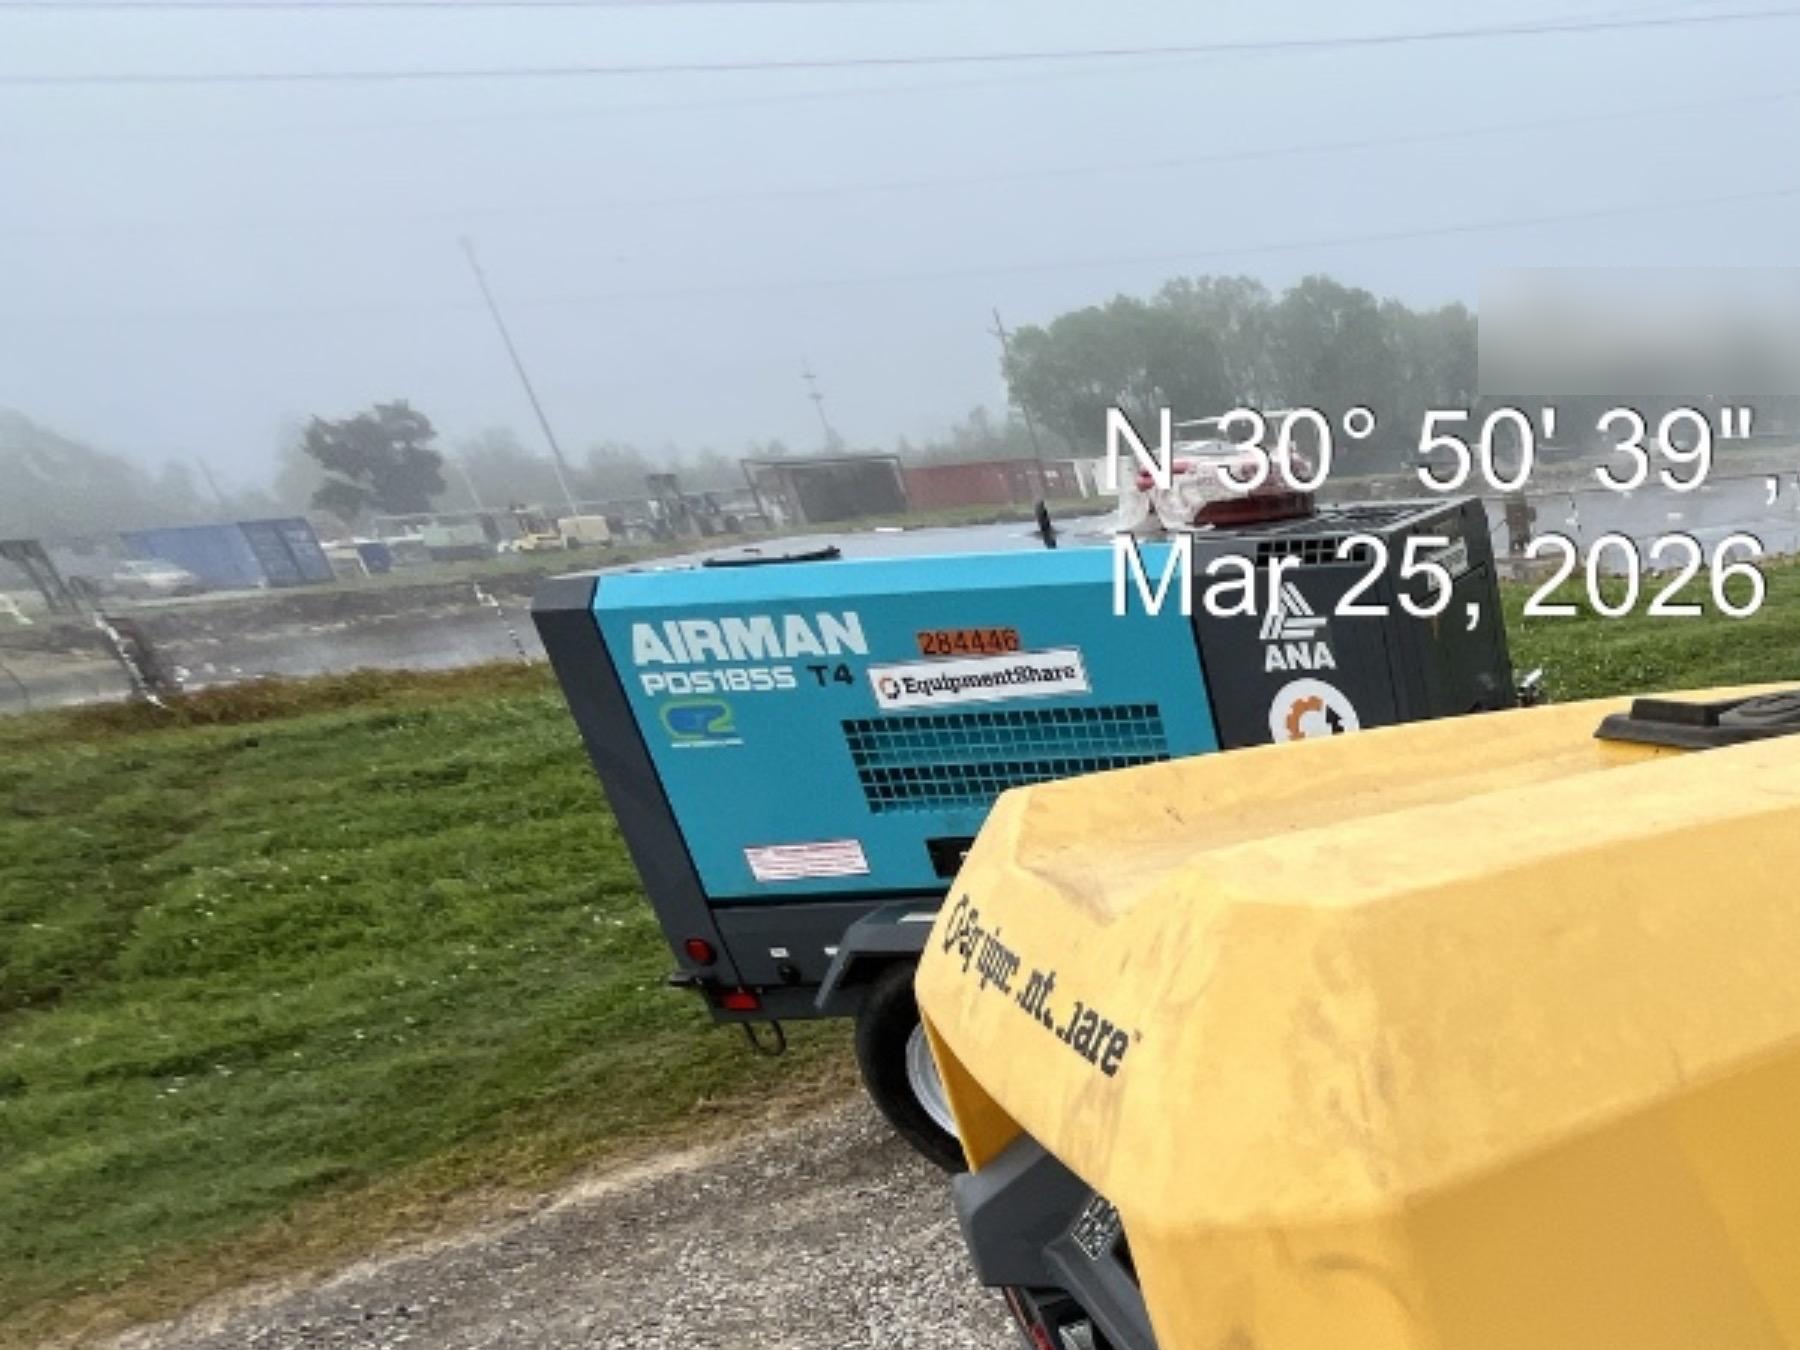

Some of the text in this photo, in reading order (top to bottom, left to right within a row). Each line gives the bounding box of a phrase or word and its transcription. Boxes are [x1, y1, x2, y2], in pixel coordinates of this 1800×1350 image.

[632, 611, 868, 666] AIRMAN
[918, 629, 1019, 655] 284446
[1265, 641, 1336, 673] ANA
[640, 666, 796, 696] PDS185S
[902, 664, 1076, 696] EquipmentShare
